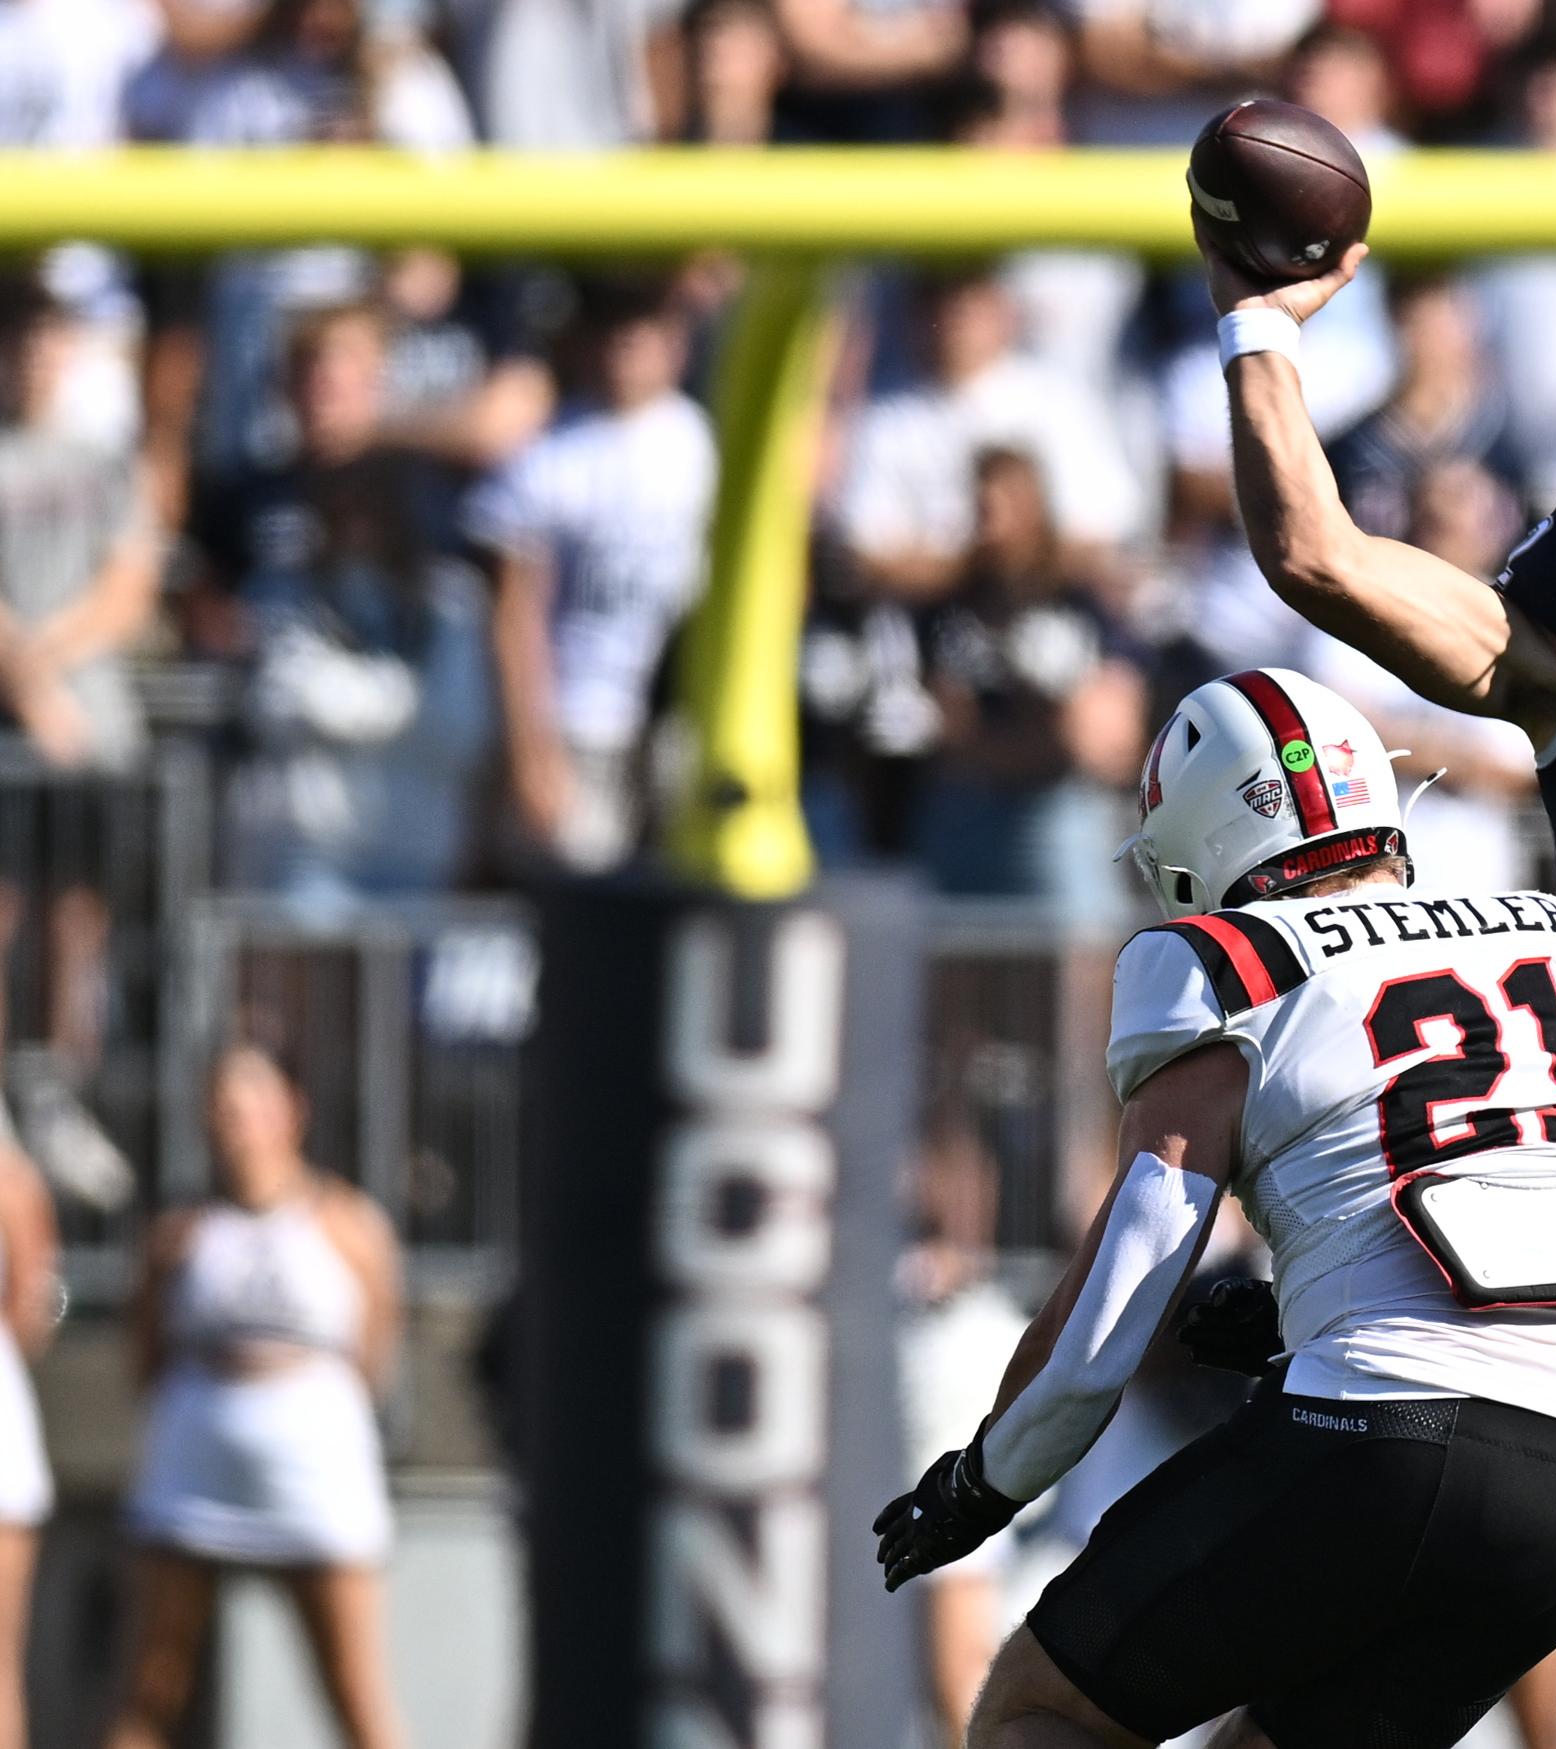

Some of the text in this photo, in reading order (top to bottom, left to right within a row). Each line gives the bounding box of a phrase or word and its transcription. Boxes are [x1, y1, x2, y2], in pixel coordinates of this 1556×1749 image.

[1285, 747, 1310, 764] C2P
[1283, 835, 1378, 880] CARDINALS
[650, 912, 843, 1749] UCON
[1292, 1407, 1368, 1433] CARDINALS
